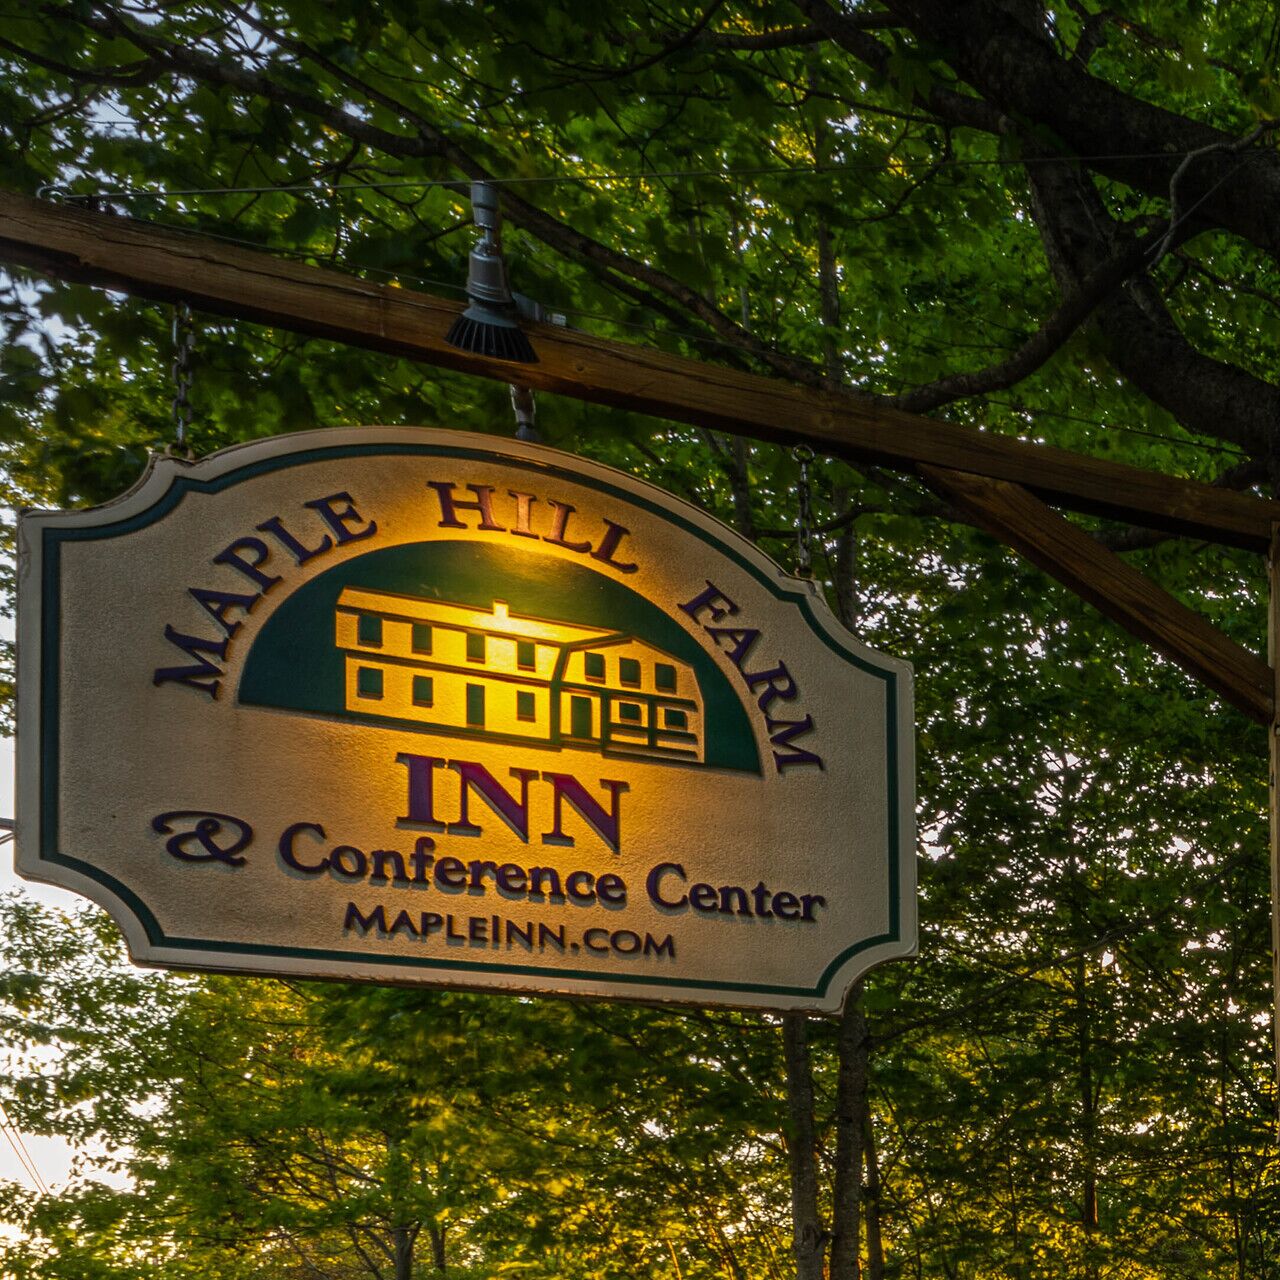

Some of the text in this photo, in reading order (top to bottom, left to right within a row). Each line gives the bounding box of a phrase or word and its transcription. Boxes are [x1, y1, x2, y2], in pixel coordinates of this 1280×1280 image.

[153, 480, 826, 774] MAPLE HILL FARM
[396, 752, 630, 853] INN
[151, 810, 827, 924] & Conference Center
